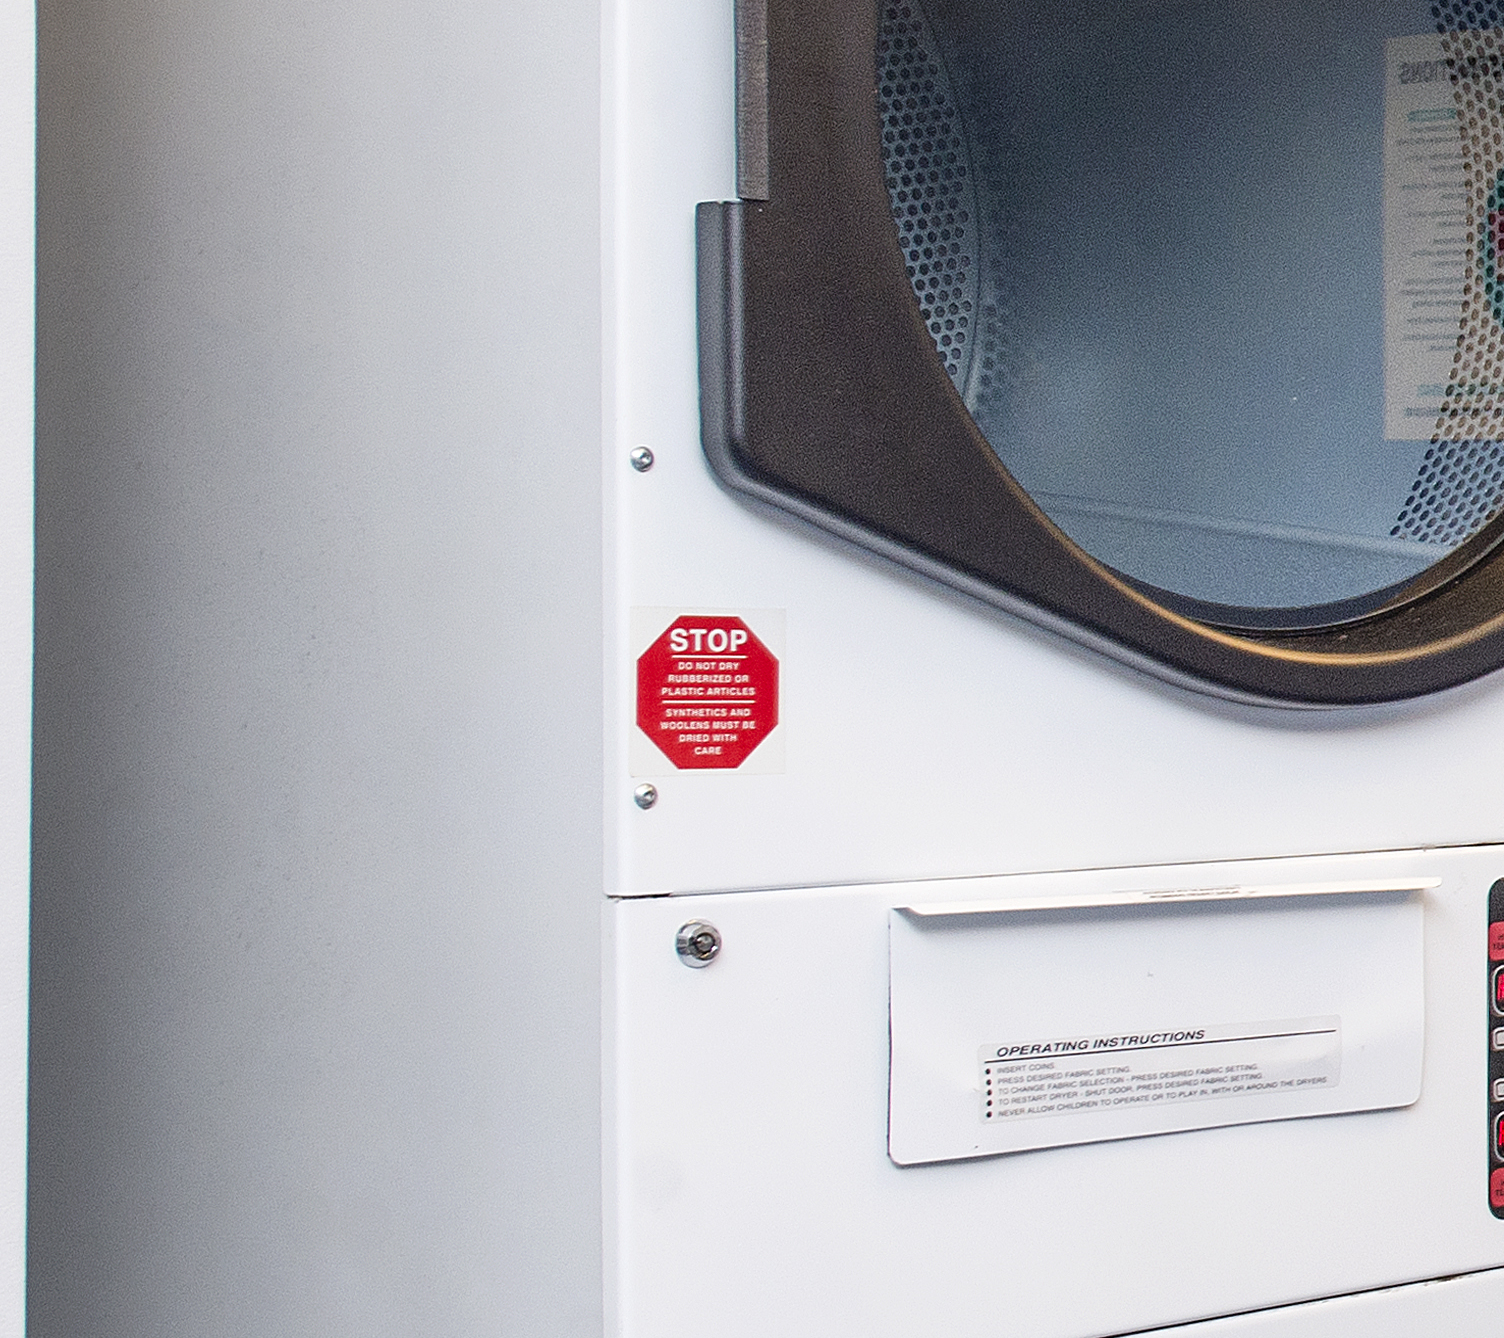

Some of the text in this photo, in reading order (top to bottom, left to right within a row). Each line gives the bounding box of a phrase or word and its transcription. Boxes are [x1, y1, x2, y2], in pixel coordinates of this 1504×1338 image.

[670, 628, 748, 652] STOP
[678, 662, 740, 670] DO NOT DRY
[667, 674, 749, 683] RUBBERIZED OR
[661, 687, 756, 696] PLASTIC ARTICLES
[665, 708, 751, 717] SYNTHETICS AND
[660, 721, 756, 730] WOOLENS MUST BE
[678, 733, 738, 742] DRIED WITH
[694, 746, 722, 755] CARE
[996, 1030, 1206, 1058] OPERATING INSTRUCTIONS
[997, 1076, 1025, 1085] PRESS
[1027, 1072, 1064, 1082] DESIRED
[1065, 1069, 1094, 1079] FABRIC
